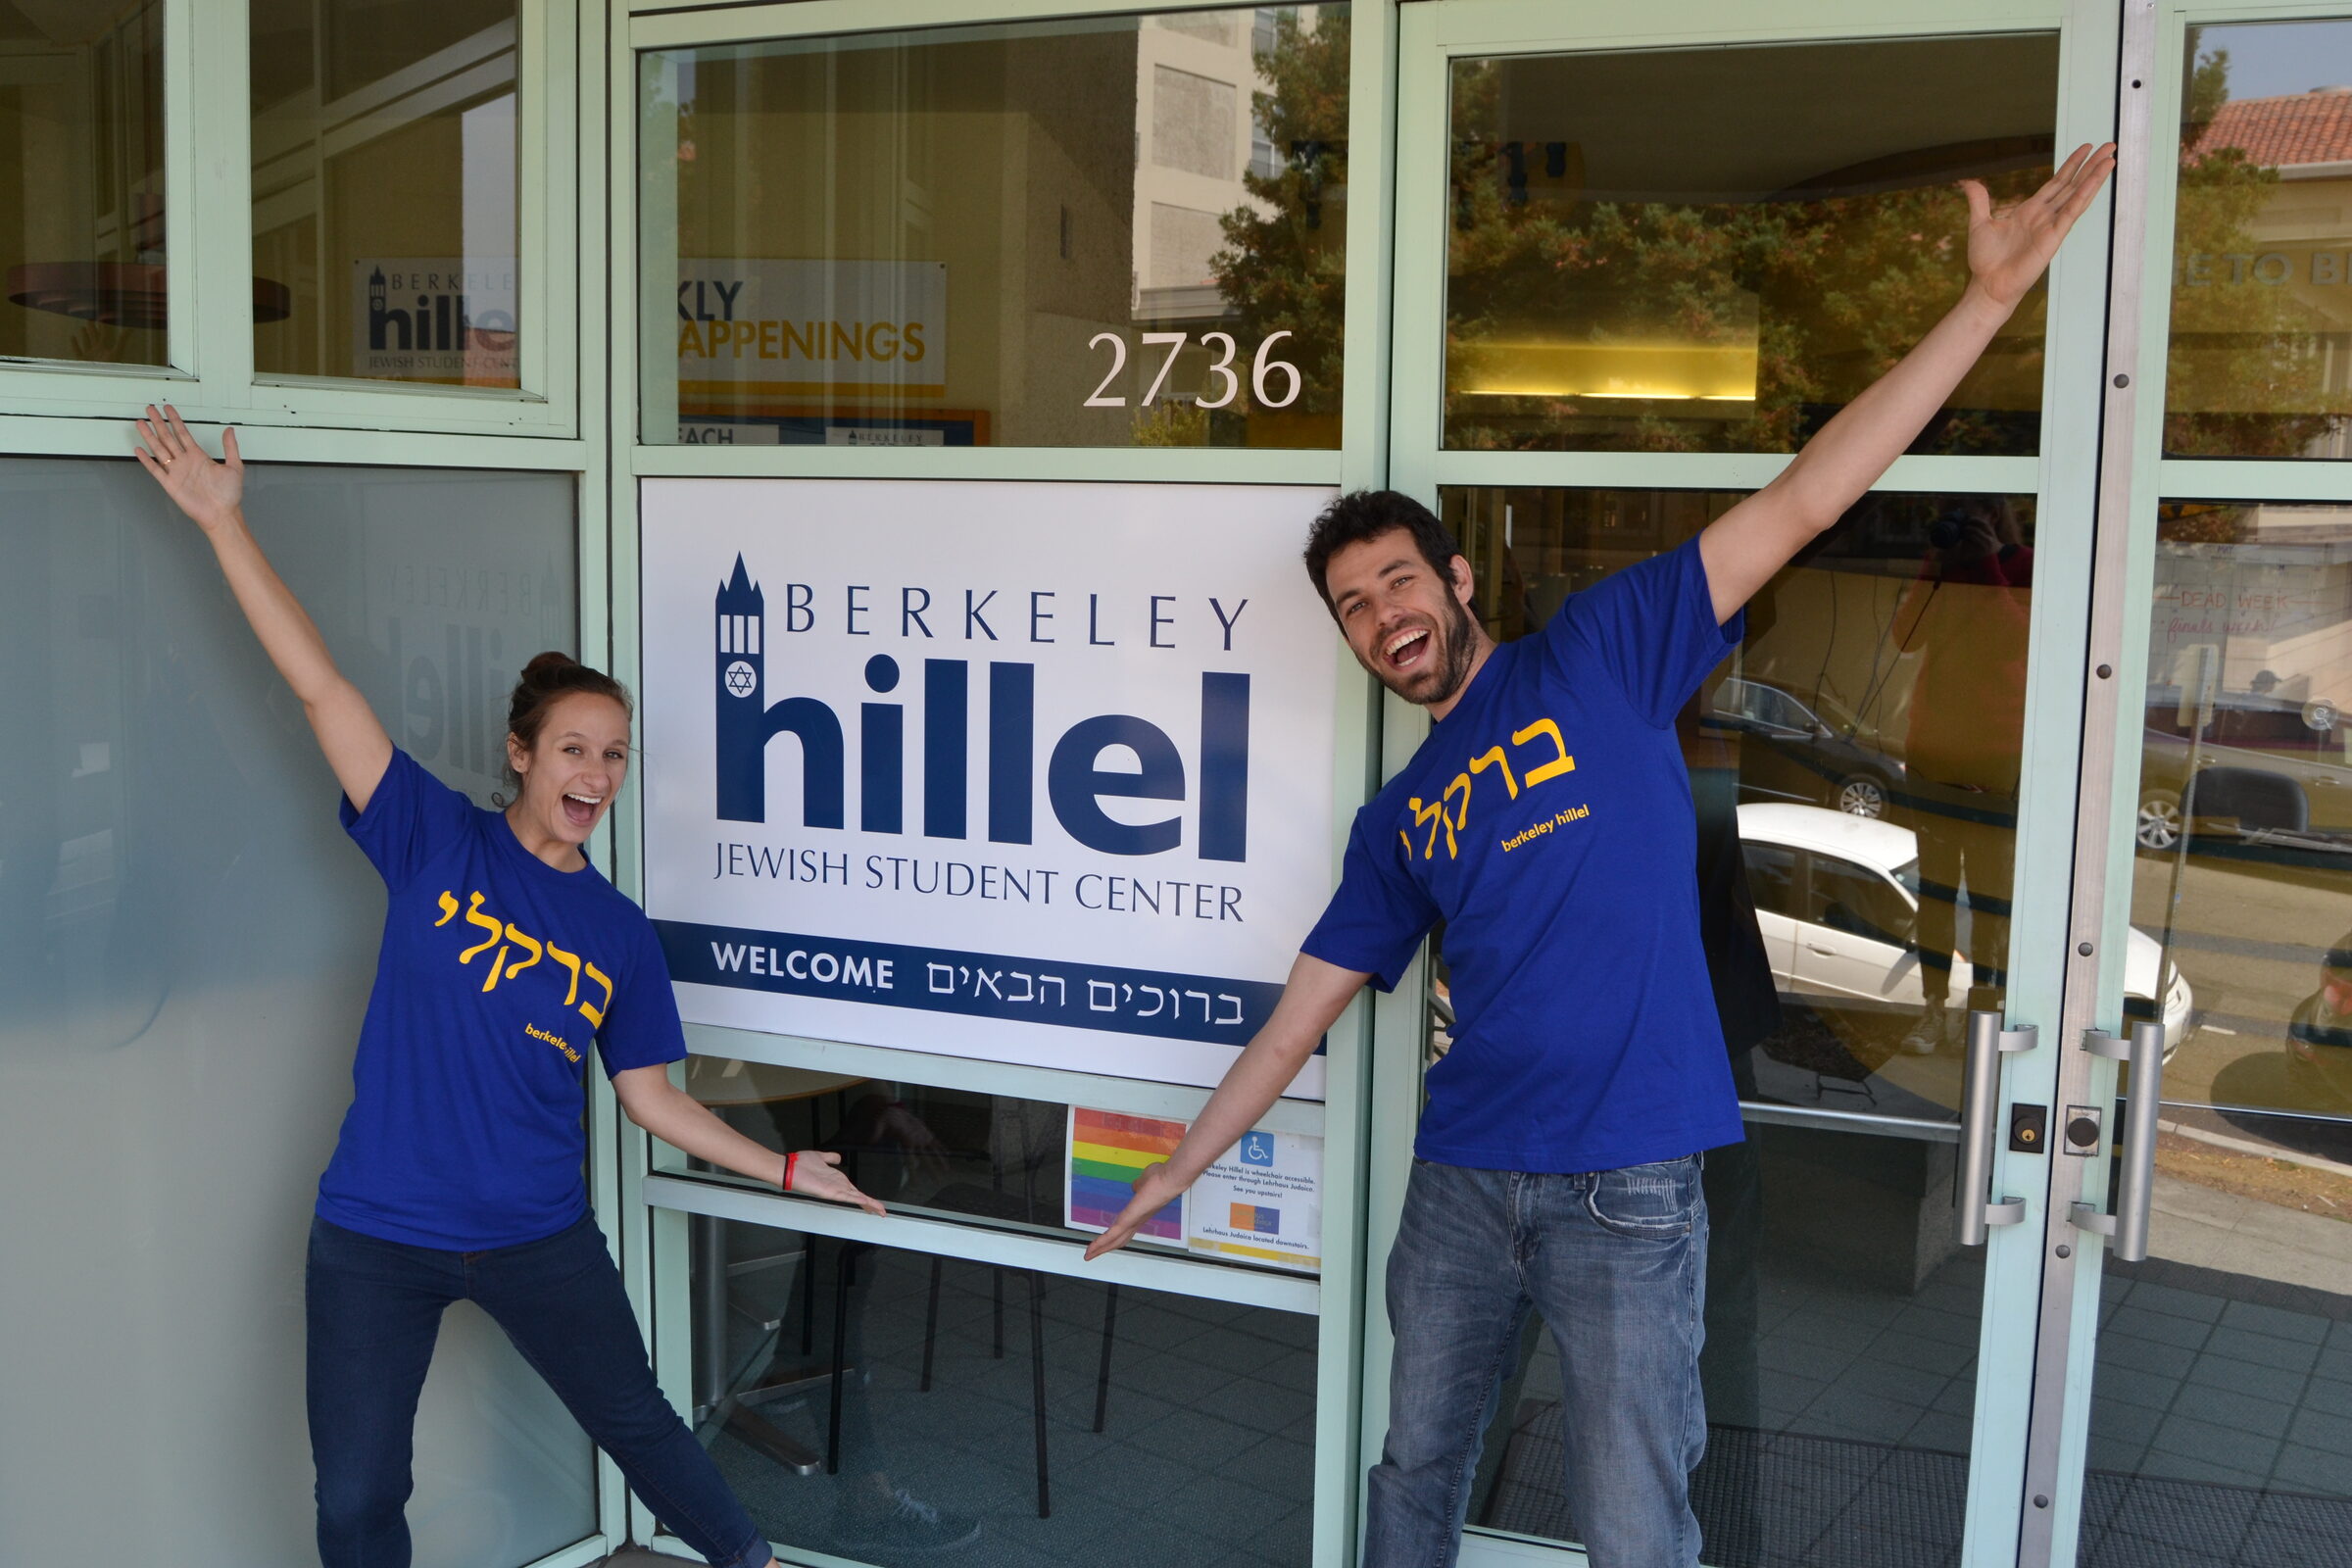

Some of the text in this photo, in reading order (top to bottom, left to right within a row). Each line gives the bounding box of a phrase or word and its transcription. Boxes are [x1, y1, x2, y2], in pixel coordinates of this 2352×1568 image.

[392, 273, 513, 291] BERKELE
[2223, 253, 2293, 286] TO
[2311, 252, 2352, 285] B
[369, 284, 515, 352] hille
[677, 319, 926, 364] APPENINGS
[368, 356, 415, 369] JEWISH
[1084, 330, 1302, 410] 2736
[785, 583, 1250, 652] BERKELEY
[2180, 591, 2288, 611] DEAD WEEK
[715, 603, 1251, 864] hillel
[1399, 718, 1576, 861] ברקלי
[1500, 804, 1591, 853] berkeley hillel
[713, 842, 1244, 922] JEWISH STUDENT CENTER
[434, 890, 613, 1030] ברקלי
[710, 941, 895, 991] WELCOME
[926, 960, 1245, 1026] ברוכים הבאים
[524, 1022, 581, 1063] berkele illel
[1208, 1162, 1228, 1173] keley
[1228, 1165, 1244, 1175] Hillel
[1250, 1169, 1284, 1180] wheelchair
[1284, 1175, 1316, 1185] accessible.
[1238, 1175, 1262, 1186] through
[1262, 1179, 1290, 1190] Lehrhaus
[1256, 1190, 1283, 1199] upstairs!
[1202, 1226, 1310, 1250] Lehrhaus Judaica located downstairs.
